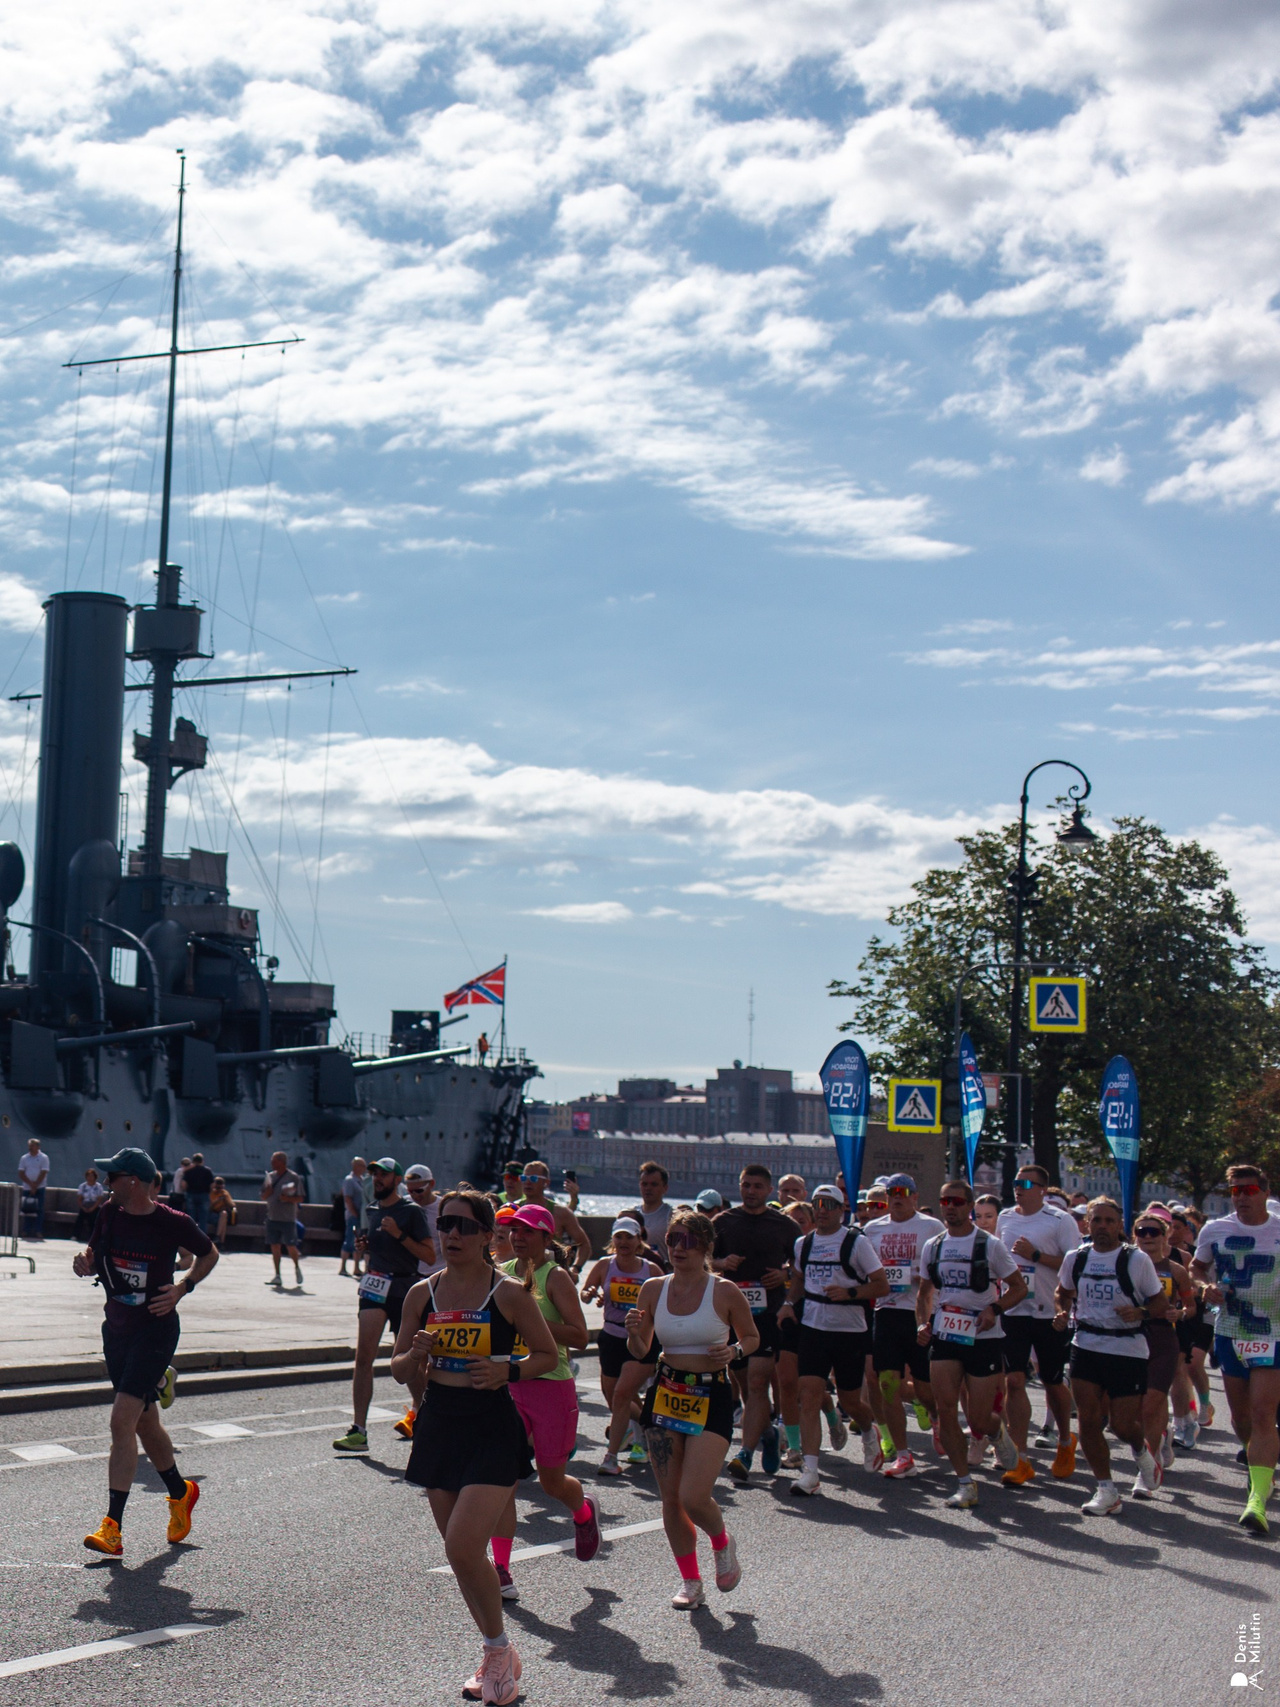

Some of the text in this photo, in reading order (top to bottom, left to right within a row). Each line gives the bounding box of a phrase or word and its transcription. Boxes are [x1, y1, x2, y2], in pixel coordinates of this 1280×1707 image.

[365, 1276, 386, 1290] 1331
[618, 1286, 638, 1298] 864
[1086, 1283, 1114, 1301] 1:59
[944, 1316, 972, 1332] 7617
[1237, 1342, 1269, 1355] 7459
[662, 1392, 698, 1415] 1054
[655, 1414, 663, 1424] E
